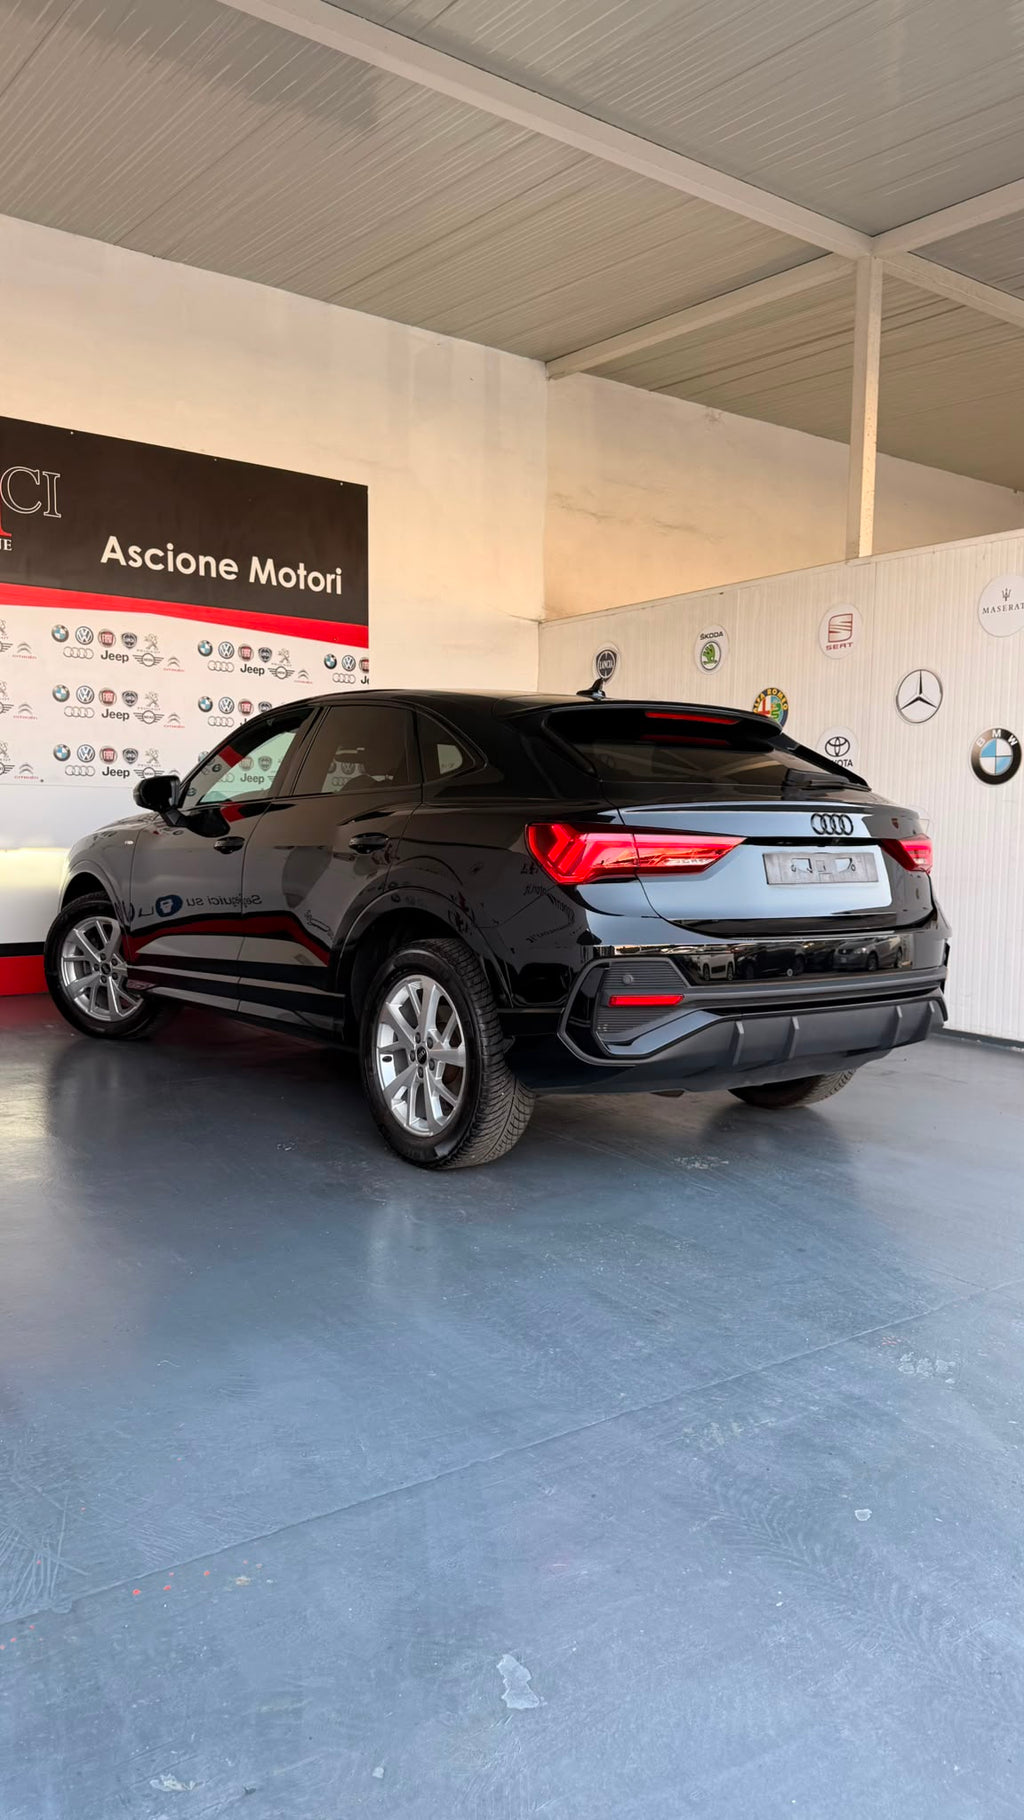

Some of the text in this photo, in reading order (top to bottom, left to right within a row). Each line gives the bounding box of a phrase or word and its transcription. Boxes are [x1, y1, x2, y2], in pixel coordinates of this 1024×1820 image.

[101, 535, 342, 595] Ascione Motori
[700, 631, 723, 640] ŠKODA
[825, 642, 853, 650] SEAT
[101, 650, 129, 663] Jeep
[240, 663, 265, 676] Jeep
[101, 708, 130, 722] Jeep
[976, 729, 1018, 747] BMW
[102, 766, 130, 779] Jeep
[240, 773, 265, 784] Jeep
